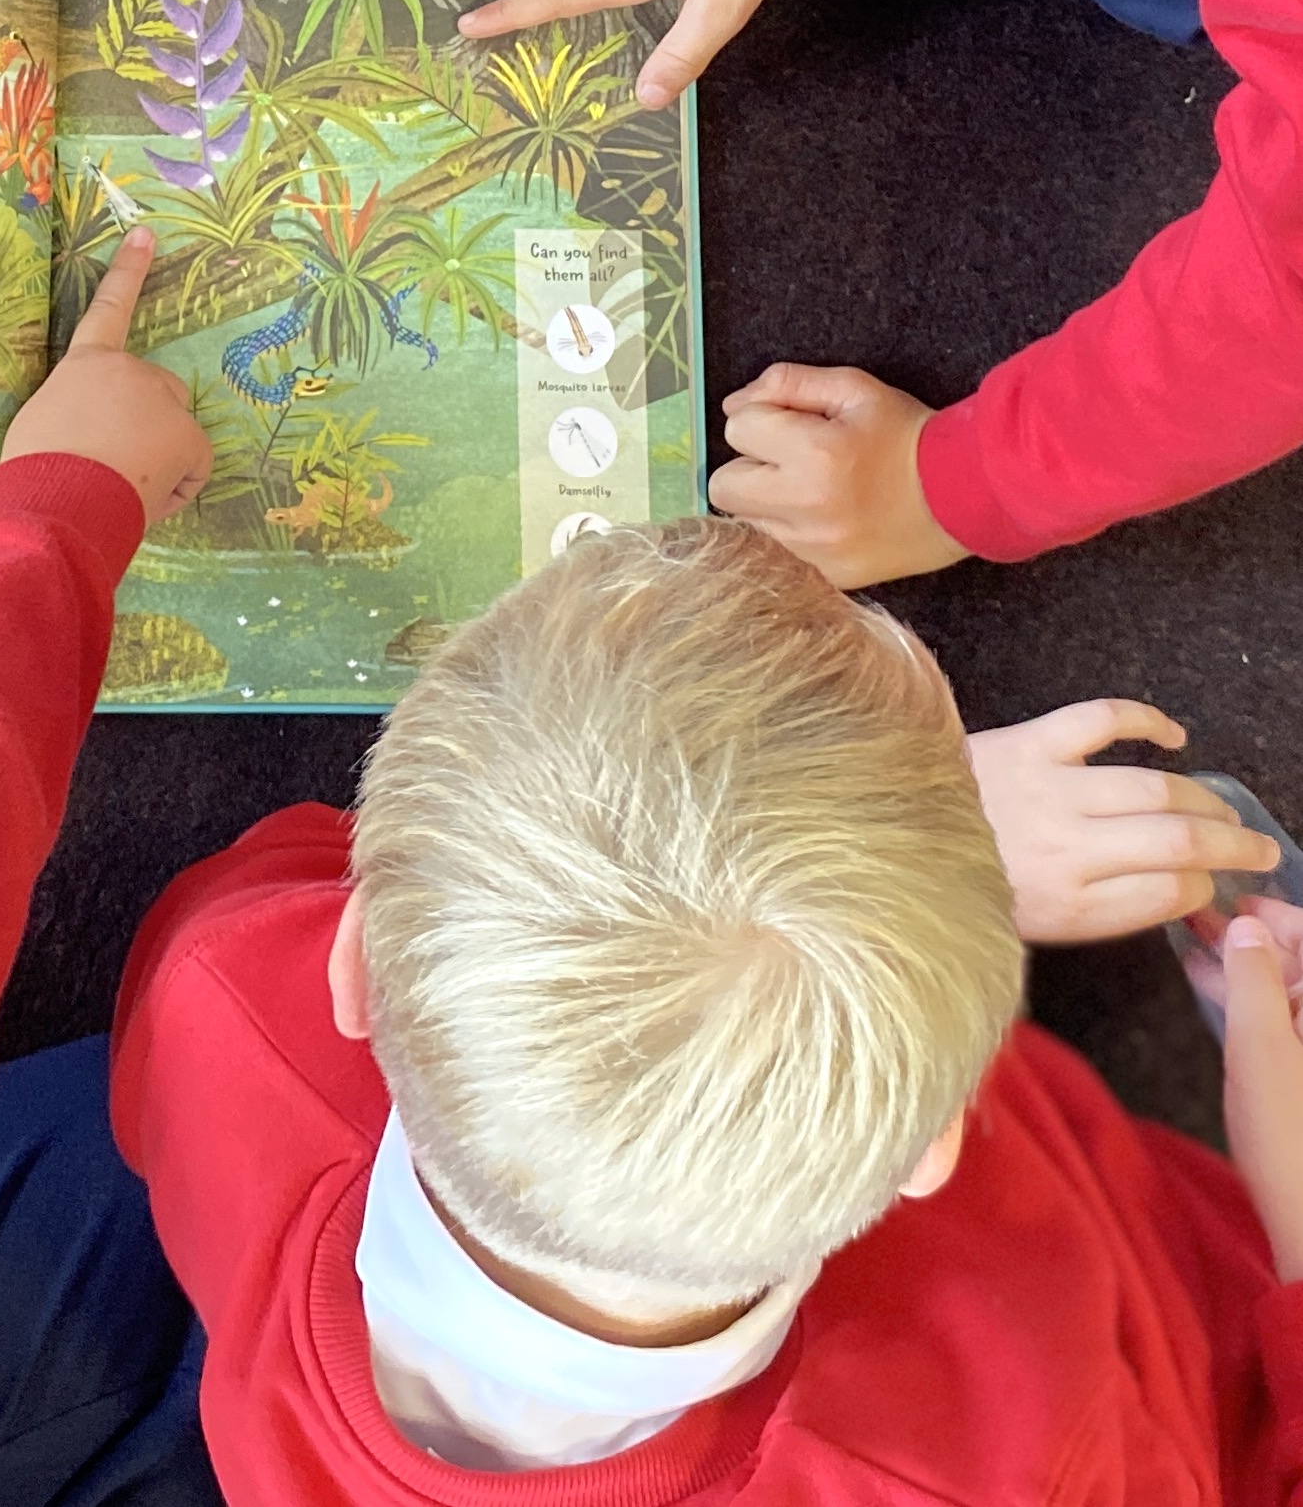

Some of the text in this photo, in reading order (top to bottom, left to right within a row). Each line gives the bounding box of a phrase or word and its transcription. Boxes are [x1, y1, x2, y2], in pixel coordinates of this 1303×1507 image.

[530, 242, 627, 263] Can you find
[544, 265, 616, 282] them all?
[537, 380, 626, 394] Mosquito larvae
[558, 484, 612, 498] Damselfly
